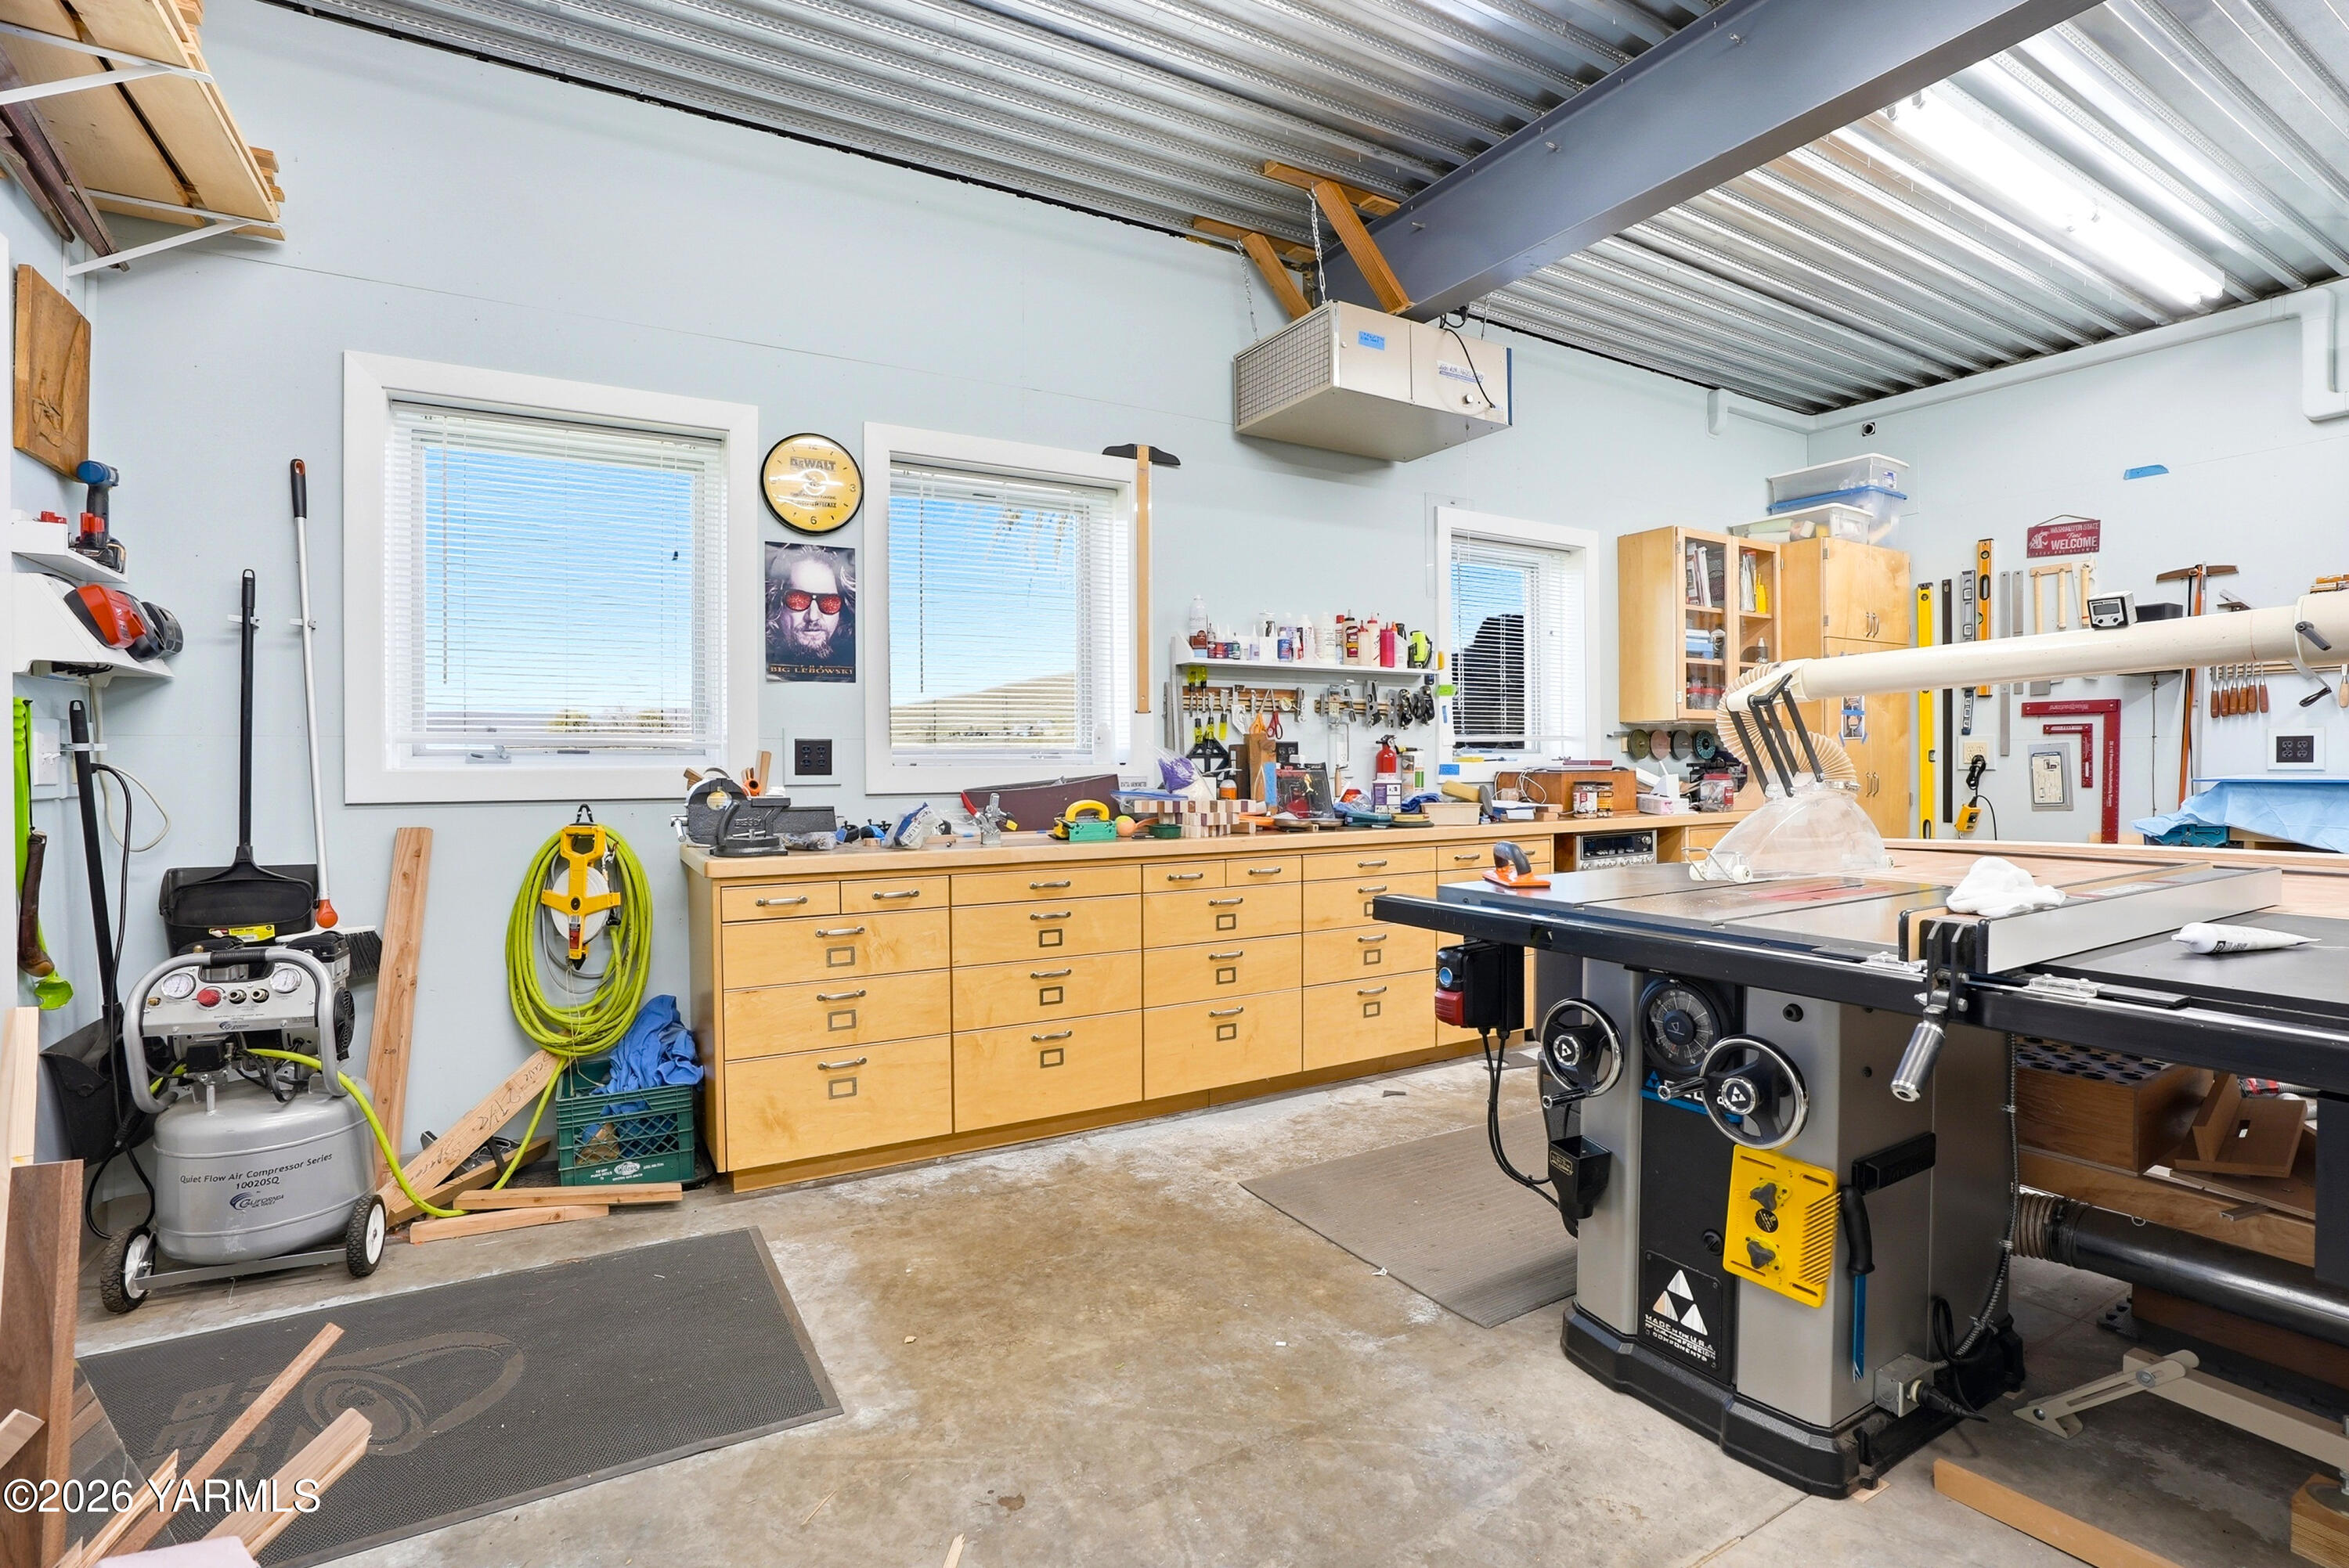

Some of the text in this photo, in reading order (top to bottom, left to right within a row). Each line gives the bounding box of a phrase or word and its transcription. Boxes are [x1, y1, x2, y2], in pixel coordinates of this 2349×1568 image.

[850, 484, 856, 492] 3
[810, 516, 817, 524] 6
[2051, 536, 2098, 550] WELCOME
[795, 666, 853, 675] LEBOWSKI
[180, 1175, 201, 1184] Quiet
[246, 1161, 304, 1179] Compressor
[307, 1153, 333, 1166] Series
